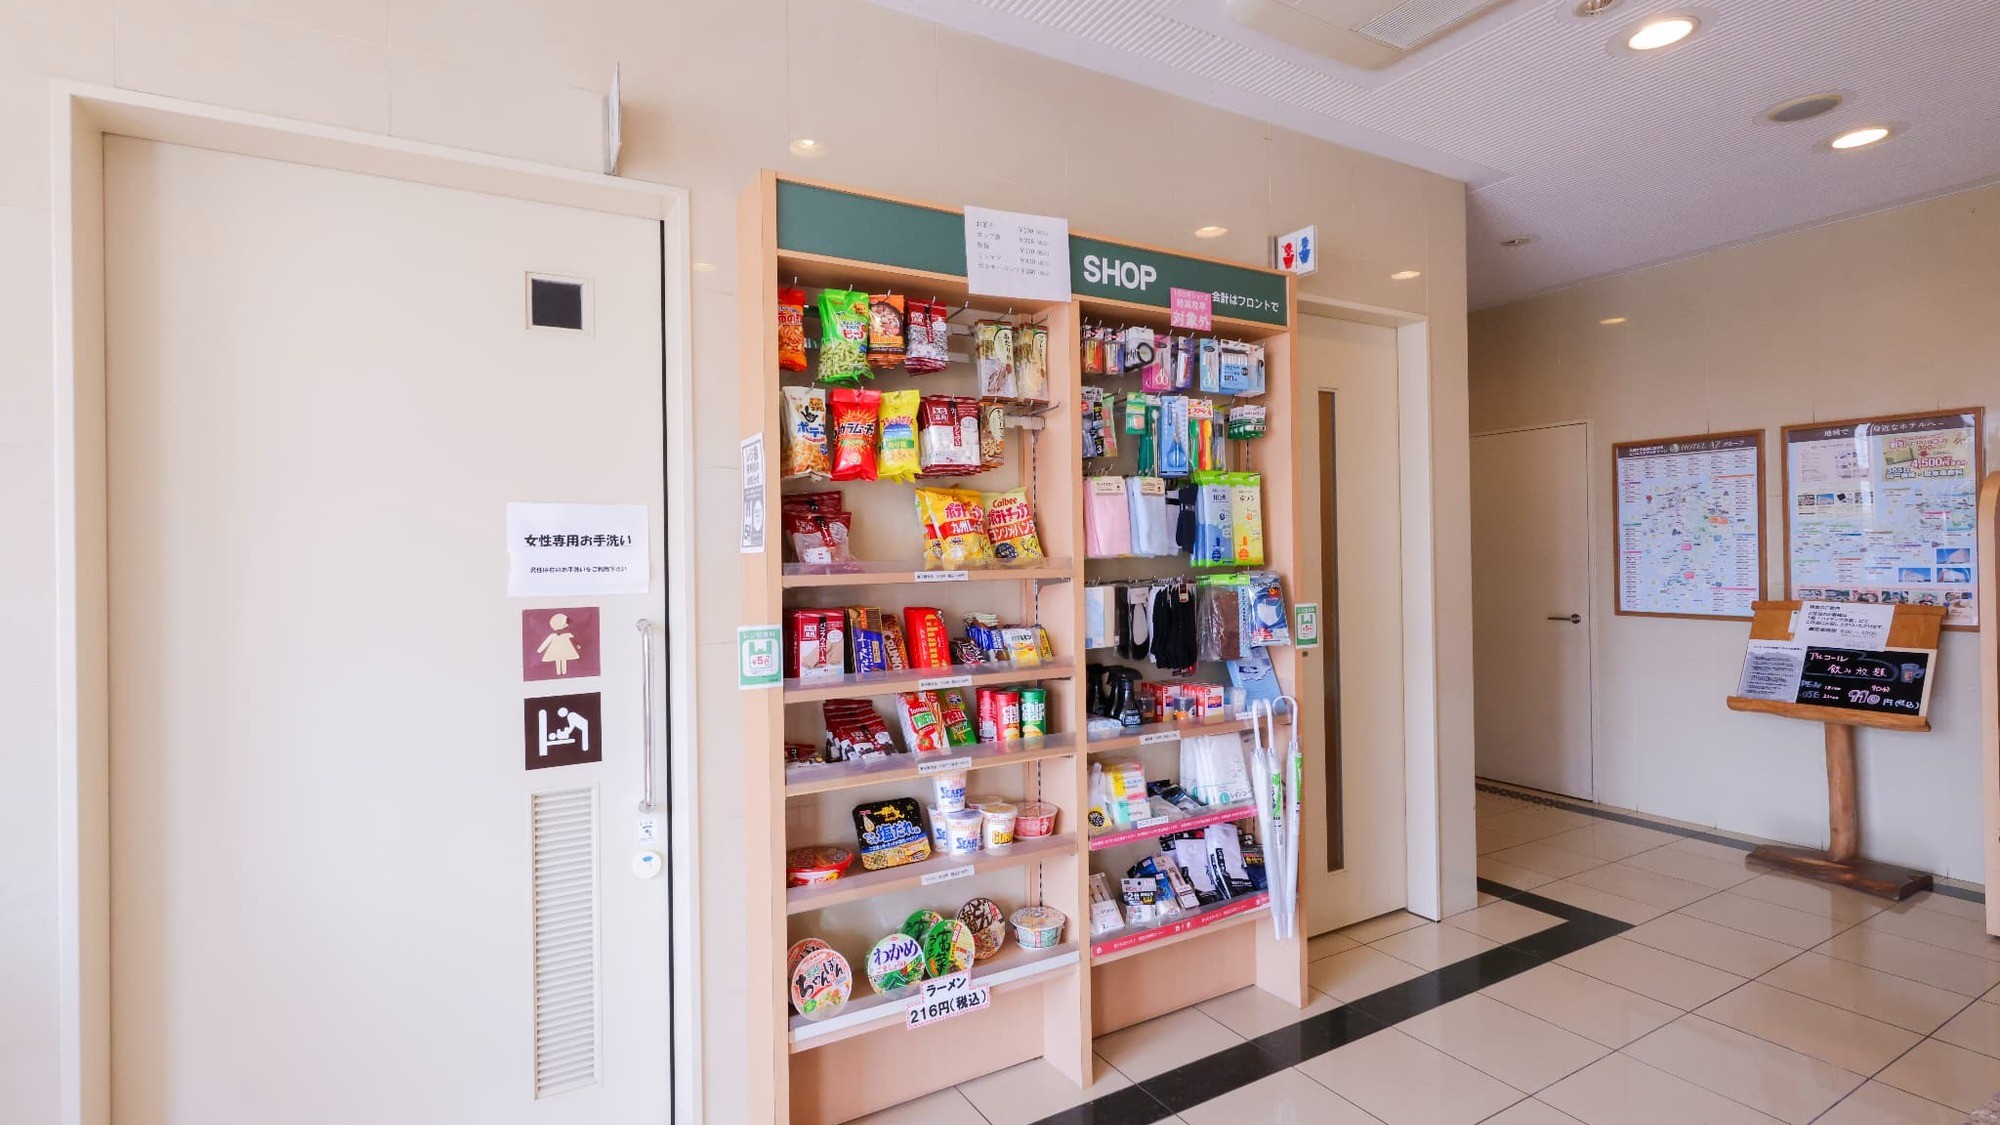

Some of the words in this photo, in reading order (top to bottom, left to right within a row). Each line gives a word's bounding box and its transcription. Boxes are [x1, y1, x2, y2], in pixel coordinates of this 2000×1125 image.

[1083, 254, 1157, 291] SHOP
[1212, 290, 1279, 312] 会計はフロントで
[1172, 311, 1209, 327] 対象外
[1681, 443, 1707, 451] HOTEL
[1709, 440, 1721, 449] AZ
[993, 498, 1017, 508] Calbee
[524, 533, 632, 547] 女性専用お手洗い
[1809, 652, 1849, 662] アルコール
[1827, 663, 1888, 678] 飲み放題
[1002, 713, 1019, 724] Sta
[876, 821, 913, 842] 塩だれ
[873, 939, 920, 966] わかめ
[926, 977, 967, 998] ラーメン
[910, 989, 987, 1024] 216円(税込)
